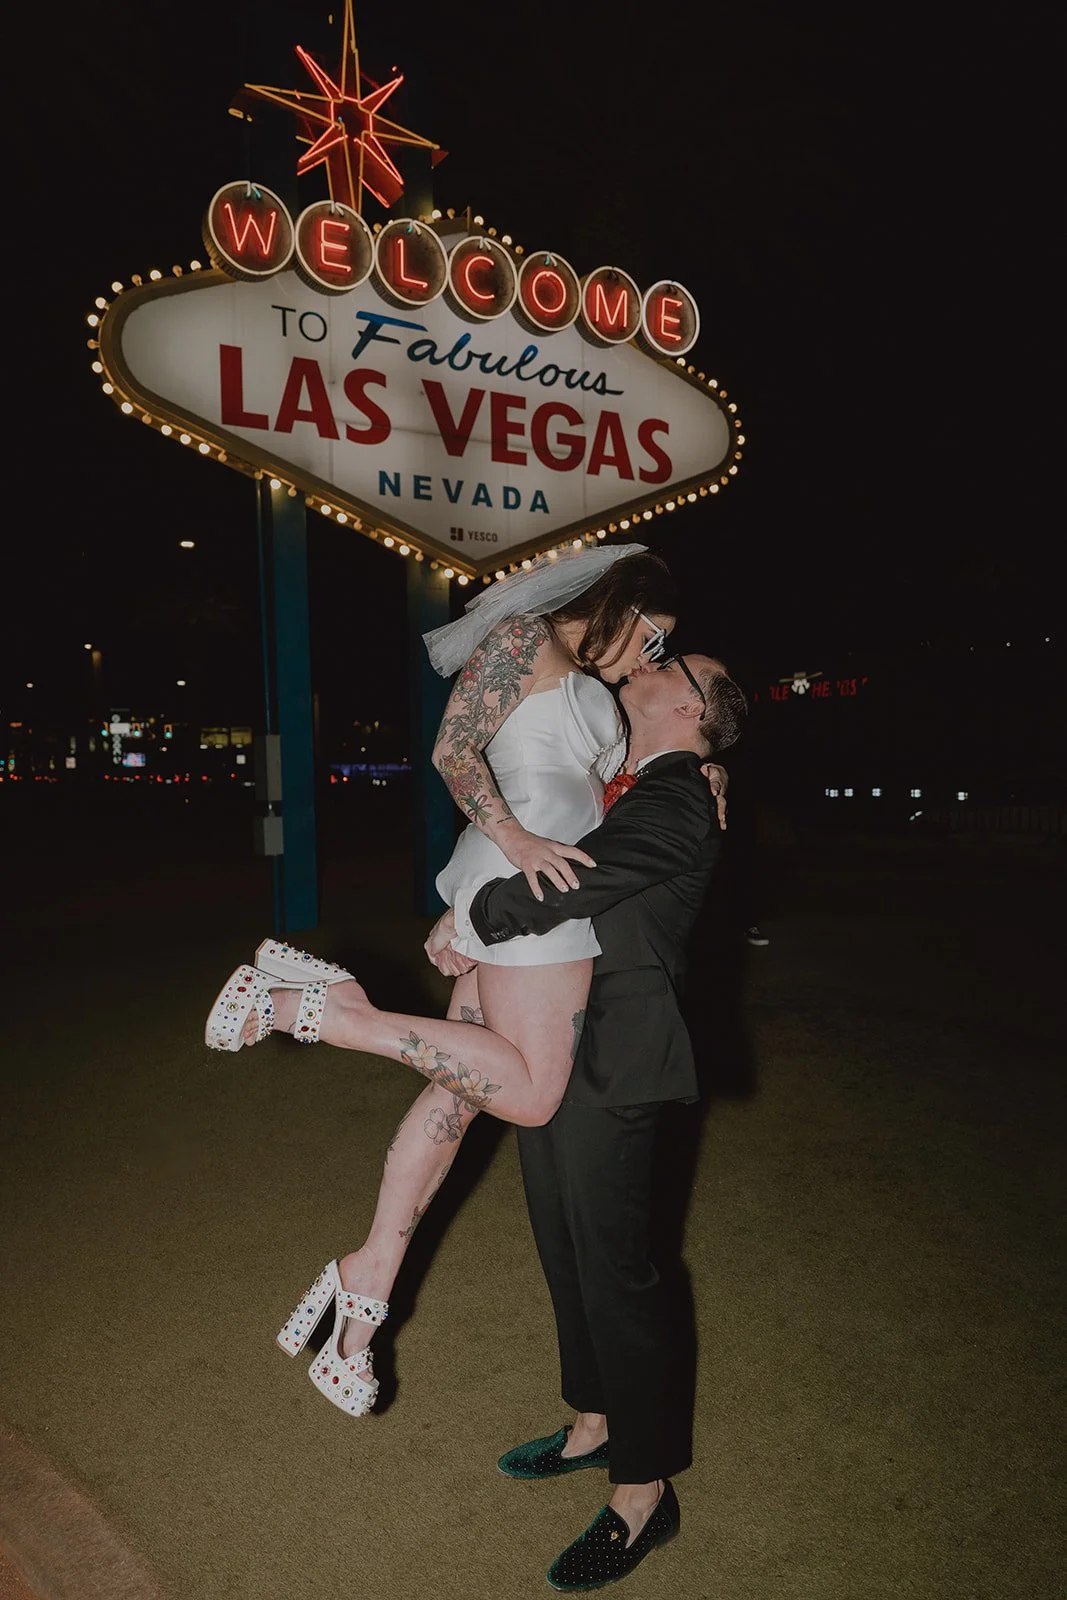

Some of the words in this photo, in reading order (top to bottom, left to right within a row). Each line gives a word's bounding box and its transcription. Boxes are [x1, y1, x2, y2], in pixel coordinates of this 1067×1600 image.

[224, 203, 683, 341] WELCOME
[271, 304, 328, 342] TO
[351, 310, 625, 396] Fabulous
[219, 343, 392, 445] LAS
[421, 378, 673, 484] VEGAS
[378, 471, 550, 514] NEVADA
[467, 530, 498, 543] YESCO
